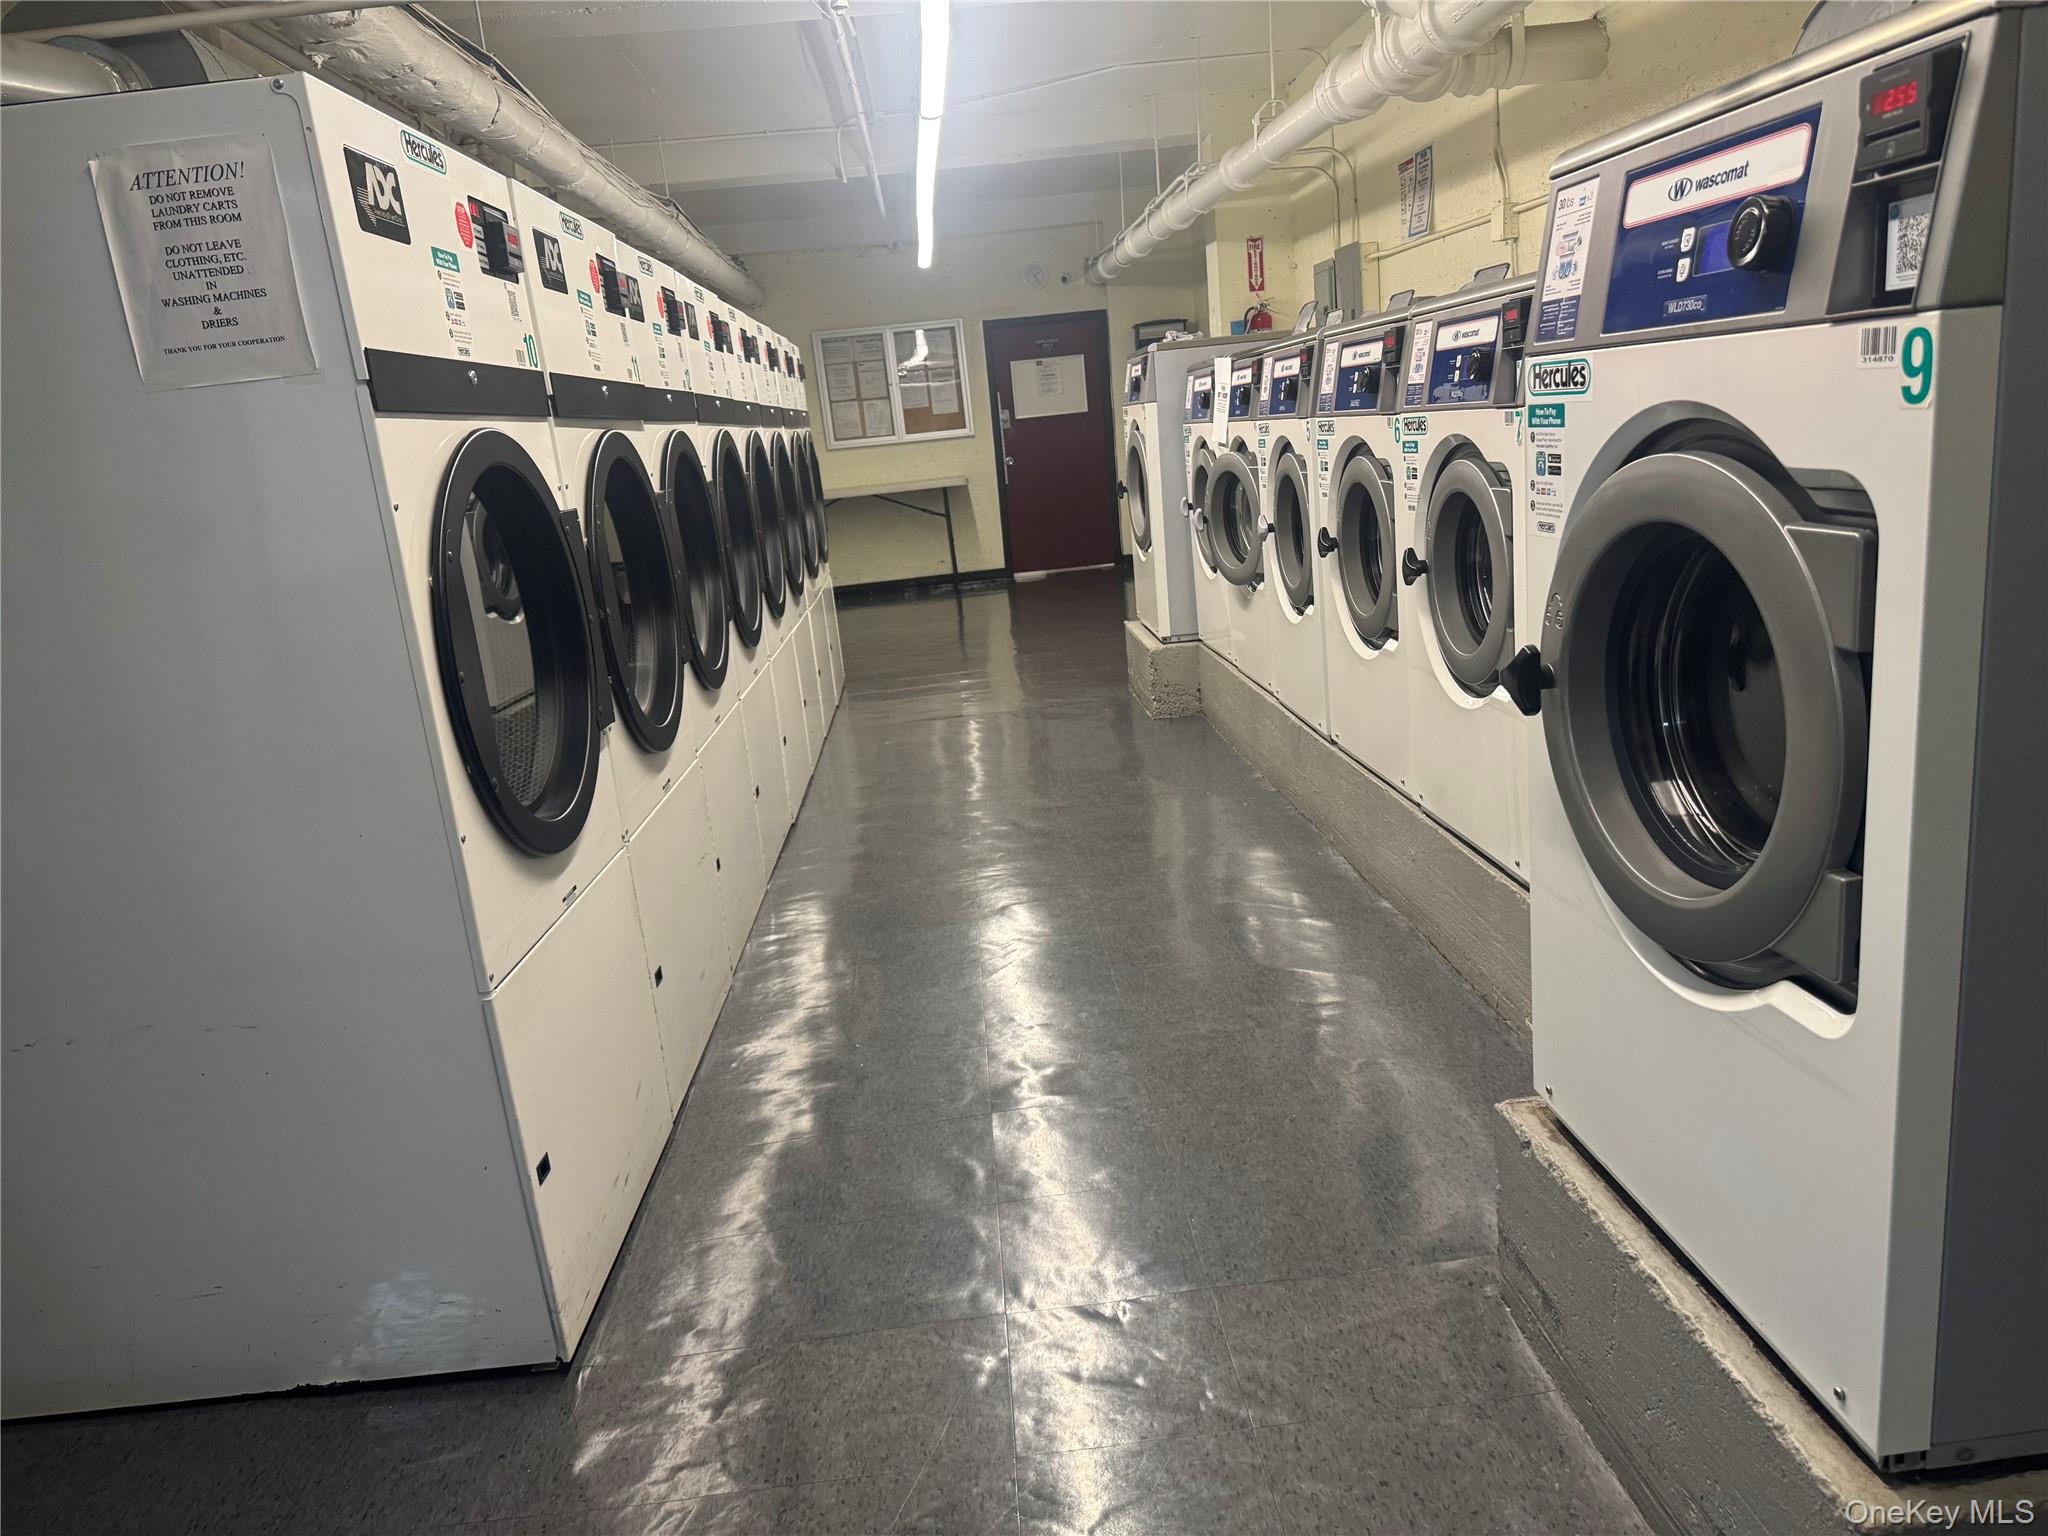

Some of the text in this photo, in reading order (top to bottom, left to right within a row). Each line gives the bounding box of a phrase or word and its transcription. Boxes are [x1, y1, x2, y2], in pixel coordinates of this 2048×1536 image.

[403, 131, 444, 169] Hercules
[129, 161, 244, 191] ATTENTION!
[1694, 160, 1750, 192] wascomat
[148, 186, 235, 205] DO NOT REMOVE
[364, 161, 402, 216] ADC
[151, 199, 238, 218] LAUNDRY CARTS
[152, 212, 242, 231] FROM THIS ROOM
[164, 238, 242, 256] DO NOT LEAVE
[165, 251, 247, 269] CLOTHING, ETC.
[172, 265, 245, 281] UNATTENDED
[205, 281, 218, 291] IN
[161, 288, 267, 308] WASHING MACHINES
[213, 306, 222, 316] &
[201, 316, 239, 330] DRIERS
[163, 335, 286, 355] THANK YOU FOR YOUR COOPERATION
[523, 332, 538, 368] 10
[1861, 355, 1894, 364] 314870
[1900, 326, 1934, 405] 9
[1533, 361, 1586, 390] Hercules
[1394, 418, 1401, 444] 6
[1403, 417, 1427, 432] Hercules
[1514, 410, 1523, 446] 7
